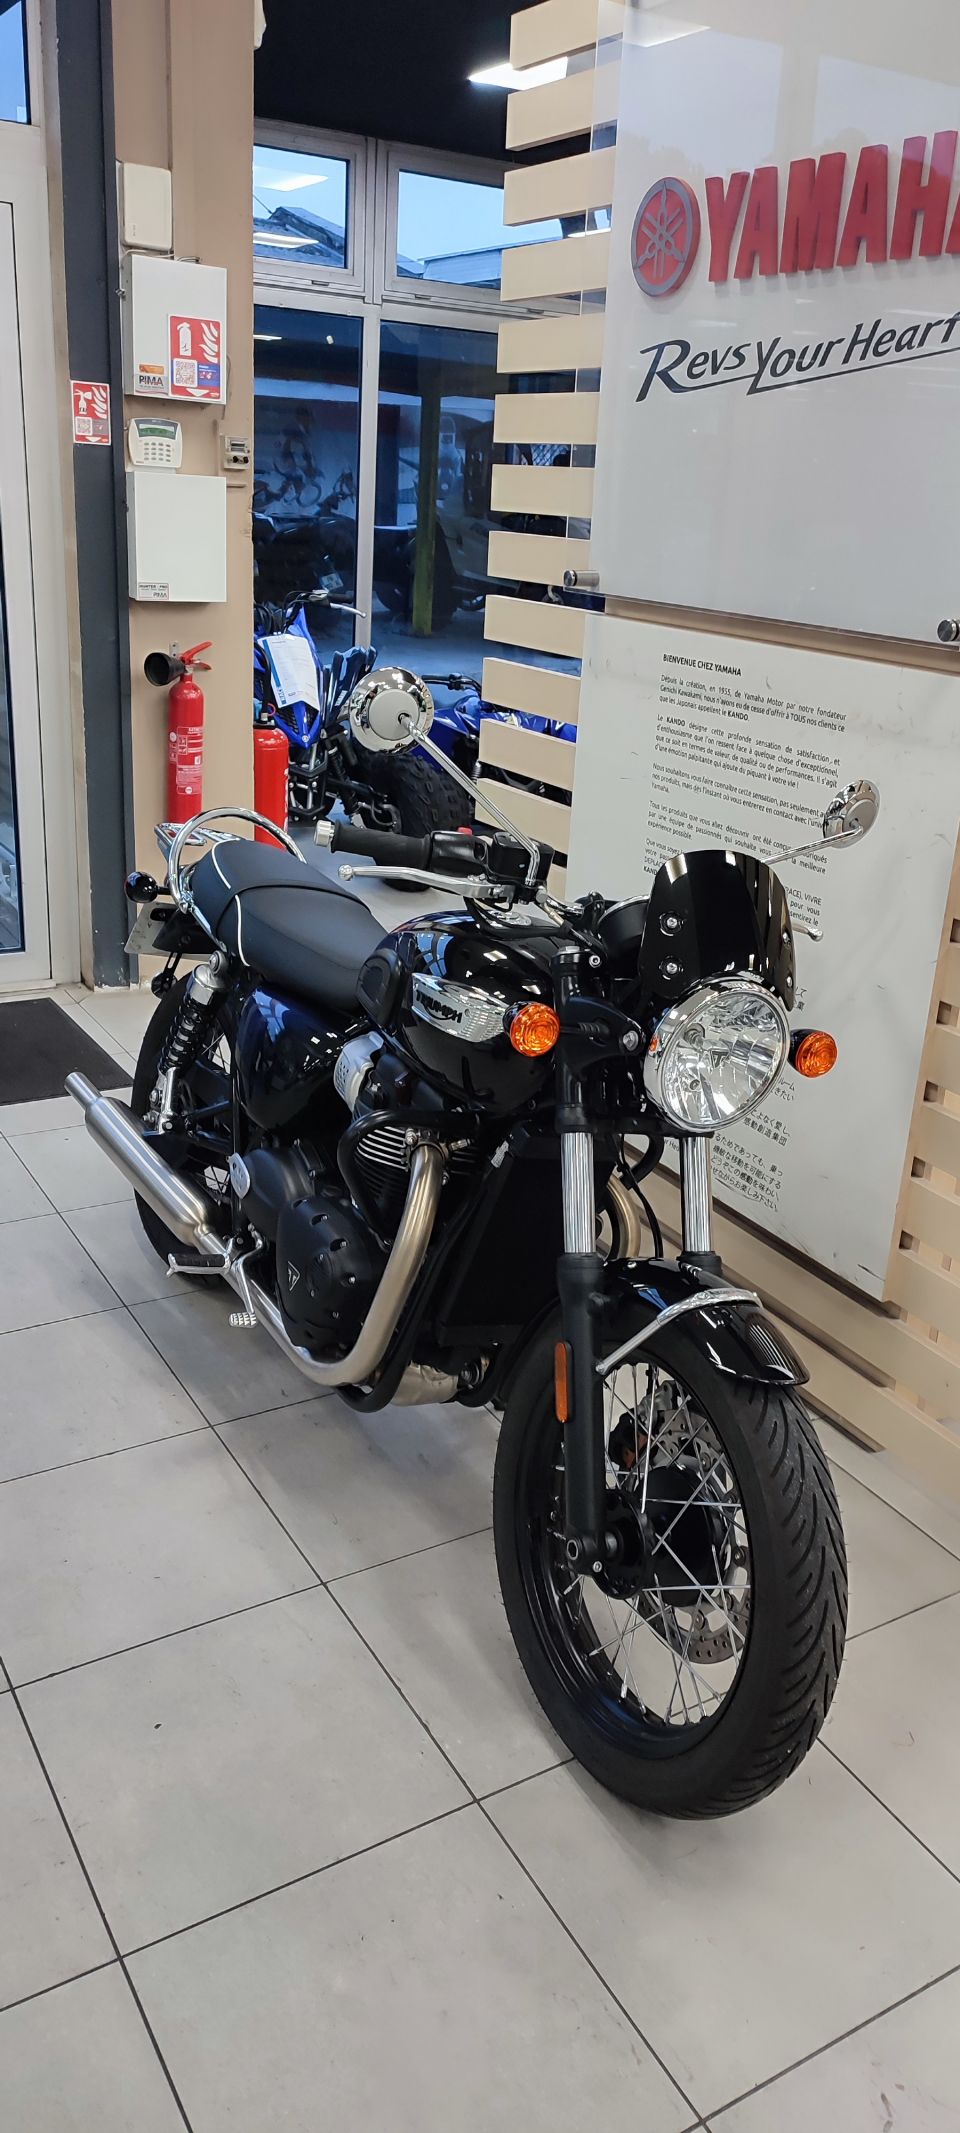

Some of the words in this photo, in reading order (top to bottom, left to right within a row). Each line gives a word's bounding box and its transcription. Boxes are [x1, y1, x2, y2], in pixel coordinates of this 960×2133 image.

[704, 130, 960, 283] YAMAH
[138, 375, 164, 387] PIMA
[634, 339, 754, 402] Revs
[746, 337, 846, 396] Your
[663, 654, 696, 668] BIENVENUE
[698, 660, 713, 671] CHEZ
[714, 663, 741, 676] YAMAHA
[659, 696, 668, 704] que
[676, 698, 697, 709] Japonais
[698, 704, 720, 714] appellent
[728, 709, 749, 720] KANDO.
[704, 695, 715, 703] nous
[716, 696, 735, 707] n'avons
[751, 705, 765, 714] cesse
[766, 707, 785, 719] d'offrir
[790, 713, 806, 723] TOUS
[807, 718, 817, 726] nos
[818, 719, 836, 730] clients
[719, 686, 731, 698] 1955,
[734, 689, 741, 698] de
[744, 691, 764, 703] Yamaha
[766, 696, 784, 707] Motor
[786, 702, 796, 710] par
[798, 705, 814, 714] notre
[816, 707, 846, 721] fondateur
[657, 723, 692, 739] d'enthousiasme
[694, 734, 703, 742] que
[705, 735, 714, 745] l'on
[716, 740, 734, 750] ressent
[736, 743, 747, 753] face
[754, 749, 776, 761] quelque
[778, 755, 794, 765] chose
[796, 758, 838, 778] d'exceptionnel,
[666, 716, 685, 728] KANDO
[689, 721, 707, 734] désigne
[711, 728, 724, 737] cette
[728, 732, 752, 744] profonde
[756, 739, 781, 751] sensation
[785, 745, 792, 754] de
[655, 742, 667, 753] d'une
[668, 746, 687, 758] émotion
[688, 752, 712, 765] palpitante
[722, 762, 738, 772] ajoute
[747, 767, 766, 779] piquant
[772, 775, 787, 784] votre
[656, 734, 664, 743] que
[672, 738, 680, 746] soit
[689, 742, 705, 753] termes
[740, 756, 758, 767] qualité
[759, 761, 766, 769] ou
[767, 762, 774, 771] de
[821, 777, 837, 788] s'agit
[652, 772, 660, 781] nos
[682, 781, 692, 790] mais
[693, 783, 701, 793] dès
[703, 786, 722, 799] l'instant
[731, 795, 742, 804] vous
[743, 799, 765, 811] entrerez
[773, 808, 794, 820] contact
[795, 814, 807, 823] avec
[808, 816, 823, 828] l'univ
[653, 762, 664, 772] Nous
[691, 774, 701, 783] vous
[702, 776, 713, 786] faire
[714, 781, 737, 793] connaître
[738, 787, 751, 797] cette
[753, 791, 778, 806] sensation,
[780, 799, 789, 808] pas
[790, 802, 819, 816] seulement
[648, 819, 672, 833] expérience
[649, 810, 657, 819] par
[658, 813, 666, 822] une
[669, 815, 685, 829] équipe
[724, 835, 732, 844] qui
[735, 839, 756, 851] souhaite
[760, 847, 772, 856] vous
[800, 860, 826, 874] meilleure
[650, 800, 660, 810] Tous
[669, 807, 688, 819] produits
[689, 814, 698, 822] que
[700, 817, 710, 826] vous
[712, 820, 723, 830] allez
[753, 833, 762, 842] ont
[763, 835, 772, 845] été
[644, 865, 658, 876] KAND
[645, 847, 657, 857] votre
[790, 900, 804, 910] pour
[807, 905, 820, 915] vous
[646, 836, 656, 847] Que
[656, 841, 666, 851] vous
[667, 845, 680, 856] soyez
[805, 893, 822, 906] VIVRE
[416, 989, 463, 1024] TRIUMPH
